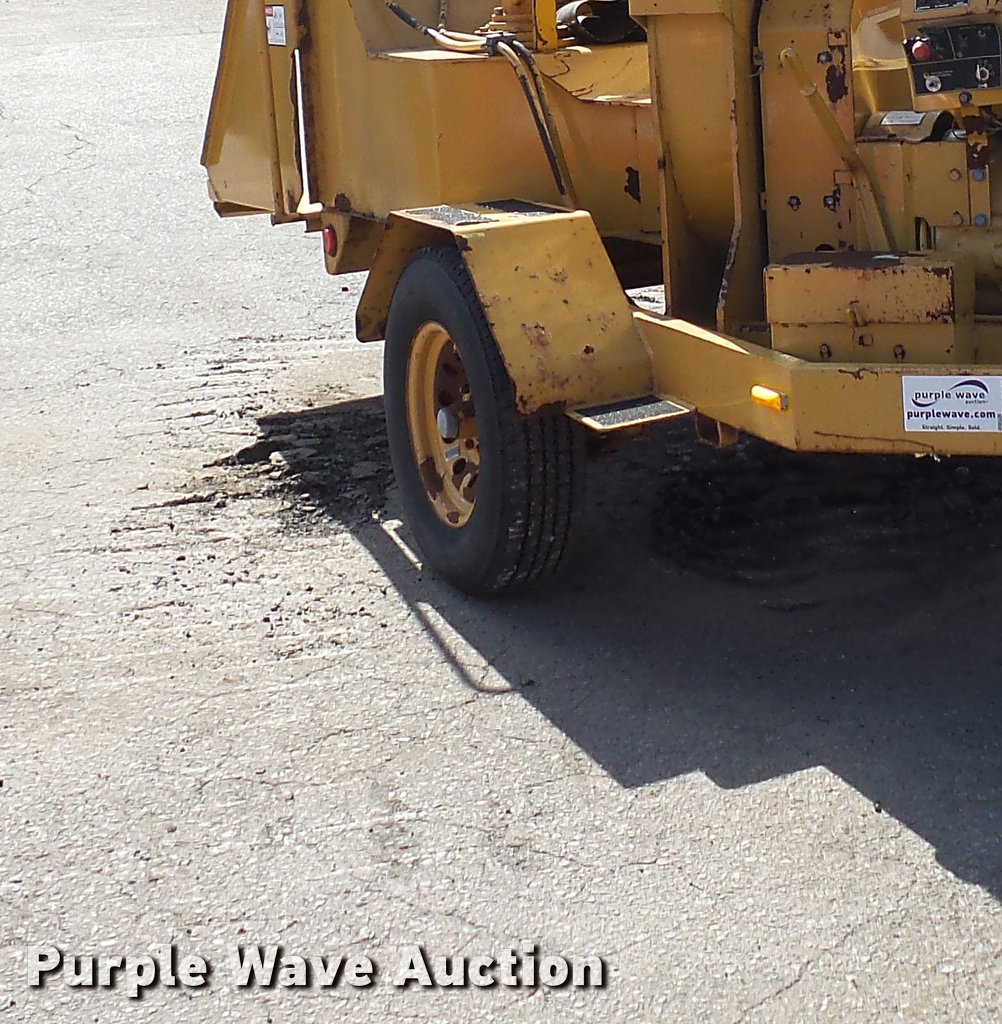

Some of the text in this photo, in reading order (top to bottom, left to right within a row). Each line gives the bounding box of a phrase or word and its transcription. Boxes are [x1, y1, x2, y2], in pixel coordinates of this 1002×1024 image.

[915, 390, 986, 401] purple wave
[907, 409, 996, 420] purplewave.com
